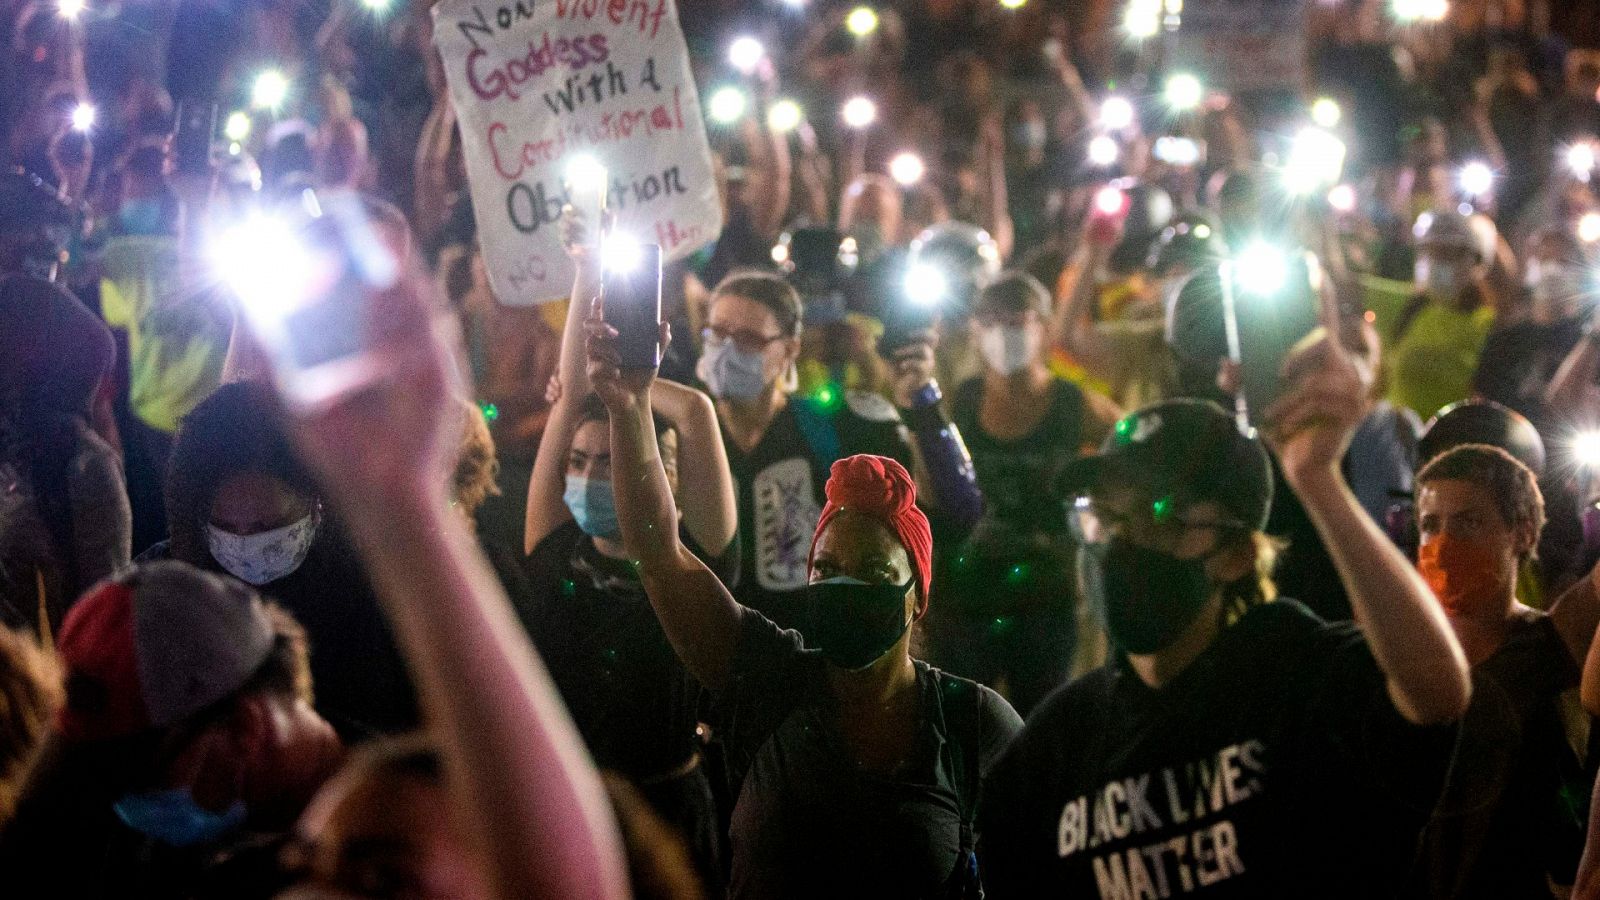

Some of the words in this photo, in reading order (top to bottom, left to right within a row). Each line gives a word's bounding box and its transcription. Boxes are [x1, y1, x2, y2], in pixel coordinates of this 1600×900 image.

[466, 31, 609, 101] Goddess
[1057, 772, 1163, 858] BLACK
[1162, 740, 1267, 824] LIVES
[1092, 820, 1245, 900] MATTER
